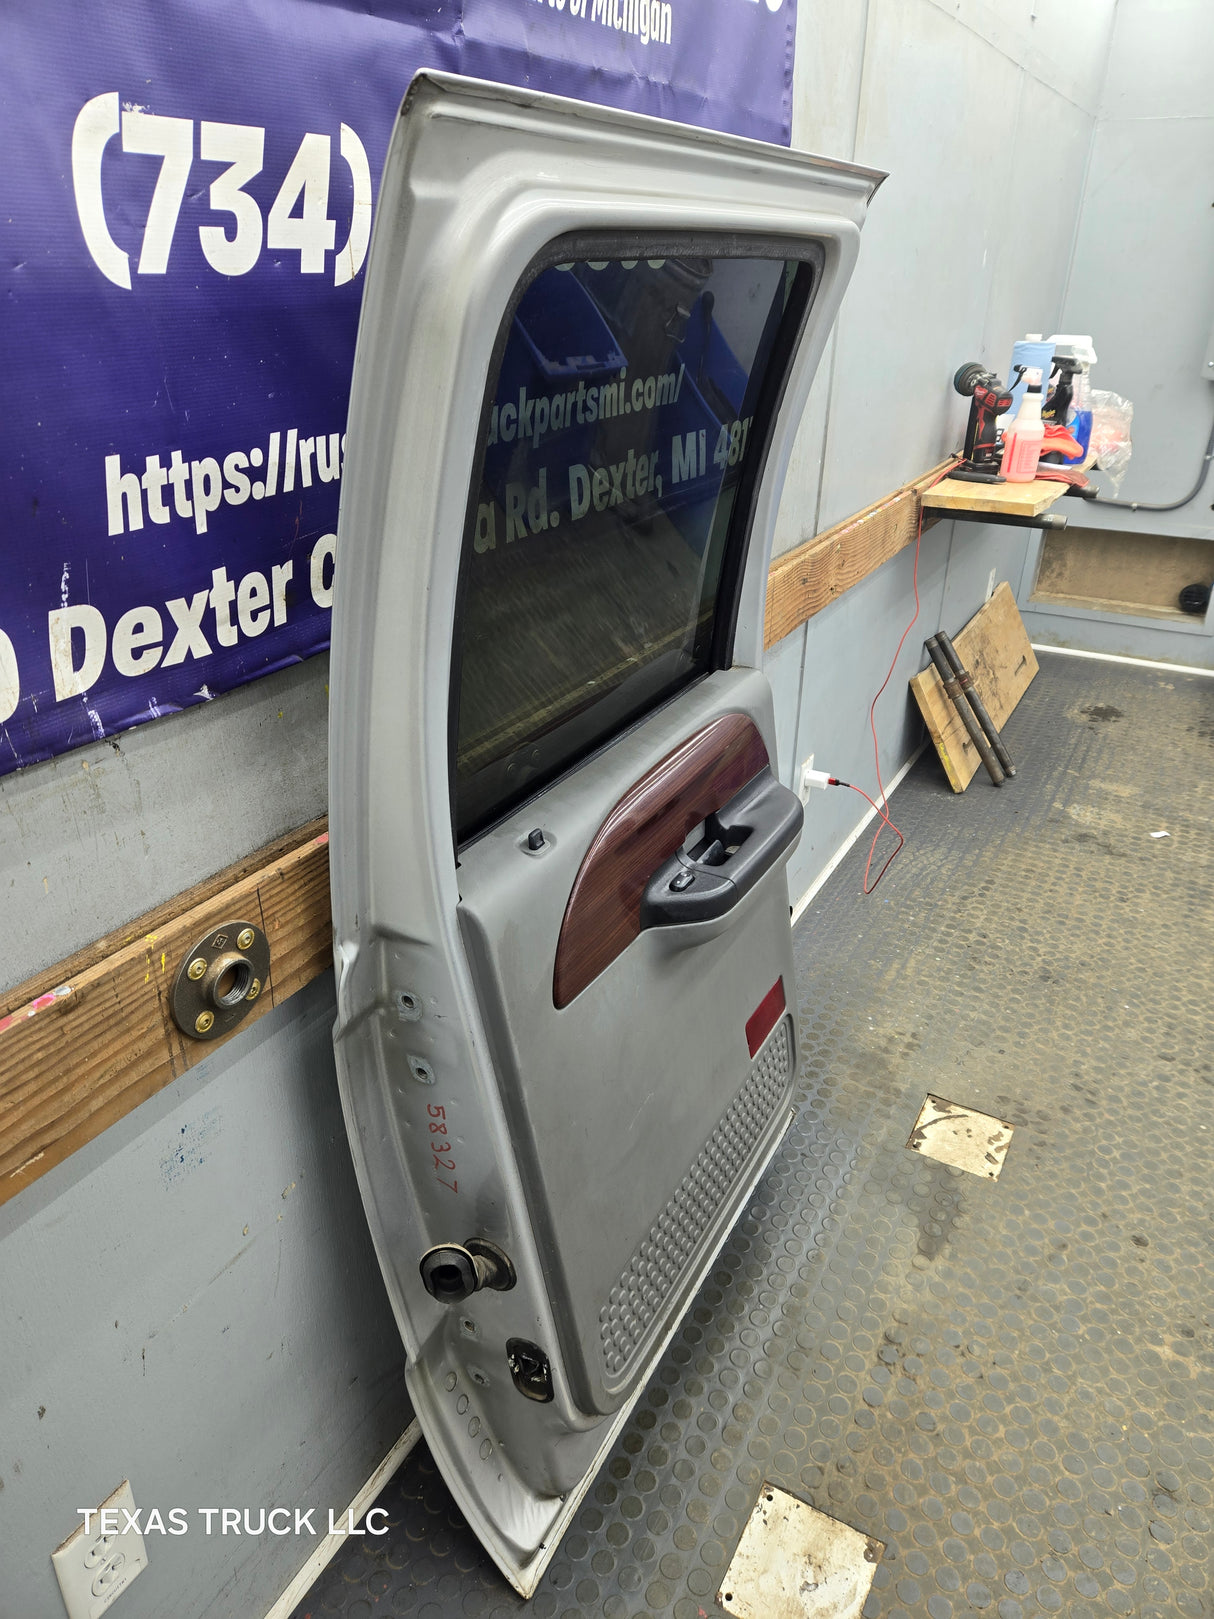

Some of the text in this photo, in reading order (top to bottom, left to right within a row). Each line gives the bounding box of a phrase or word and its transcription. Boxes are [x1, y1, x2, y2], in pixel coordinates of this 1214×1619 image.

[71, 91, 372, 290] (734)
[48, 559, 294, 703] Dexter
[505, 466, 560, 544] Rd.
[568, 448, 663, 521] Dexter,
[671, 428, 707, 485] MI
[713, 415, 754, 470] 481
[426, 1103, 459, 1194] 58327
